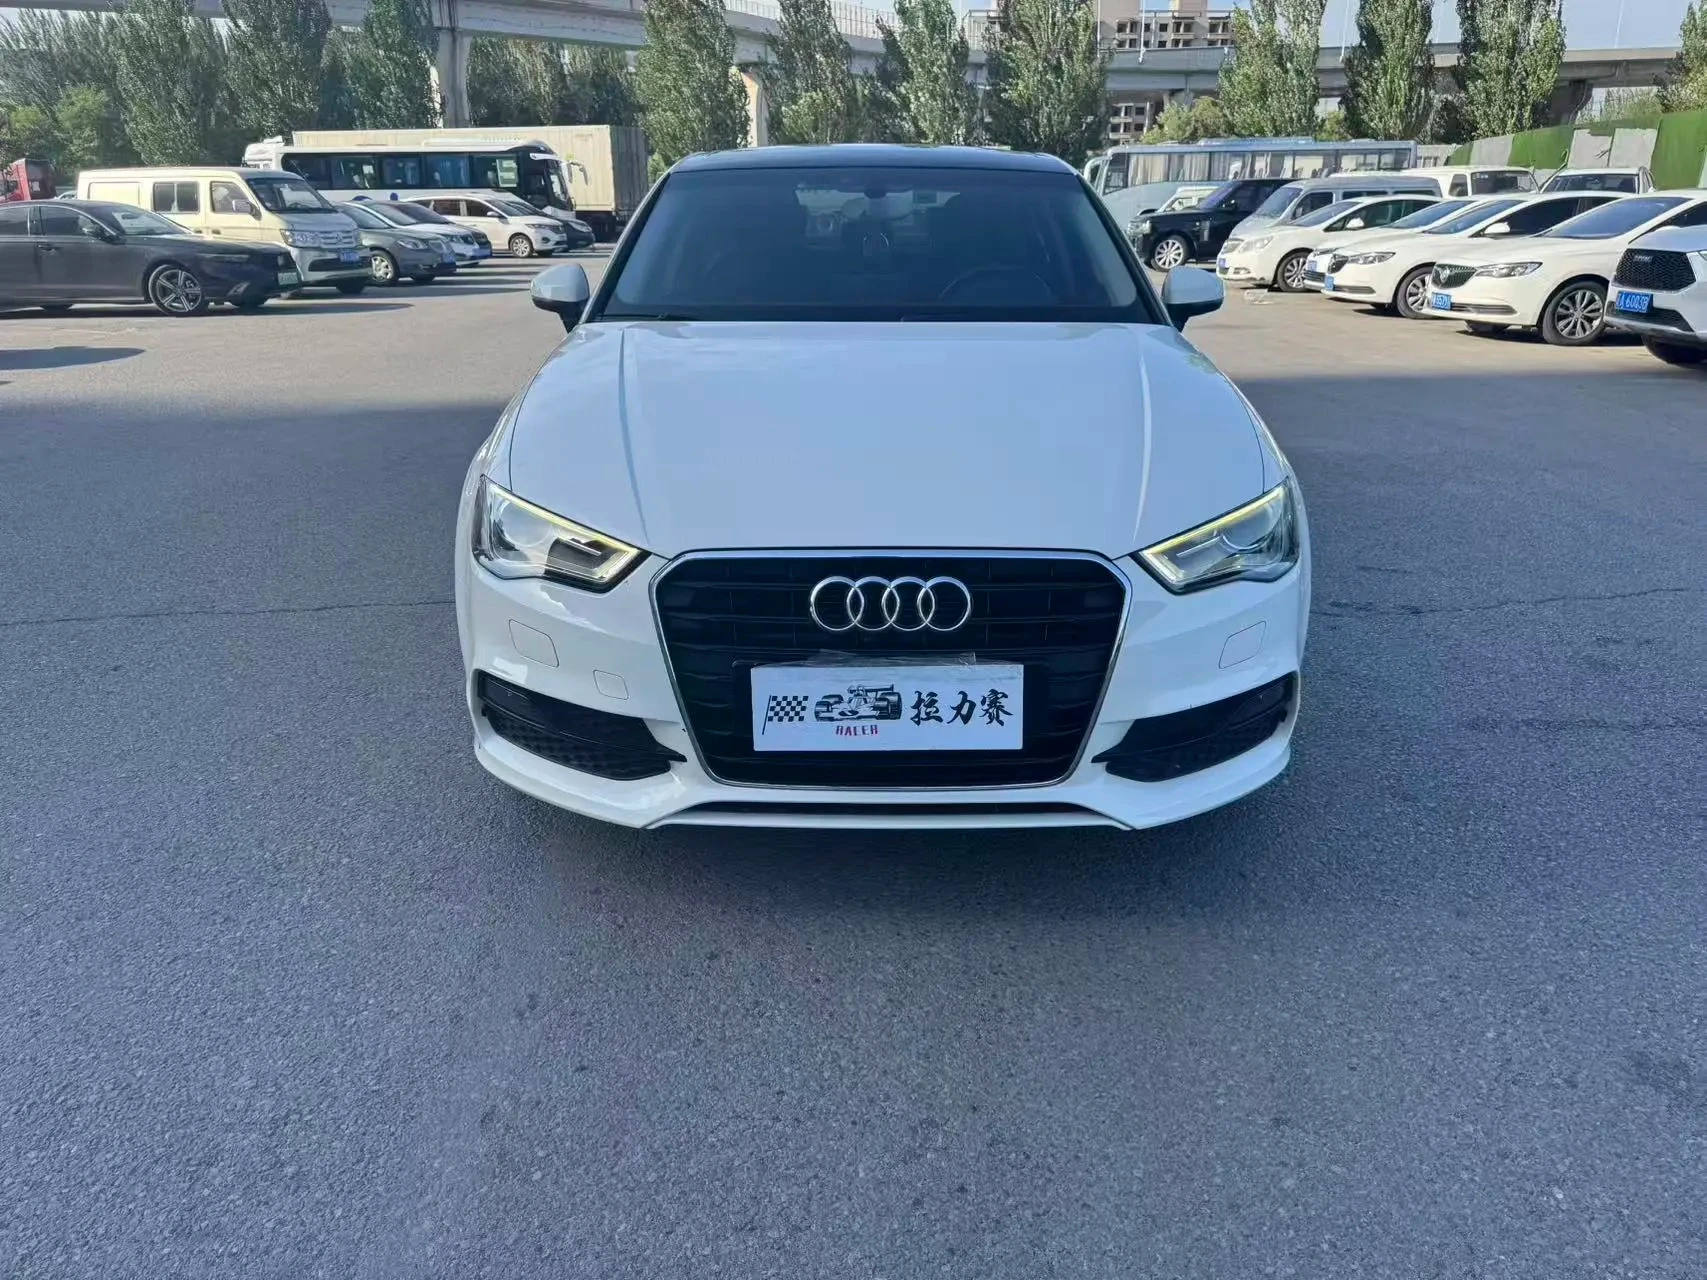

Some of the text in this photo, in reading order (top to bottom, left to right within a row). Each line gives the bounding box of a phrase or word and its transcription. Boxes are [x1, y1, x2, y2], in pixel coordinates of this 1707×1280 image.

[910, 689, 1013, 726] 拉力赛
[835, 724, 878, 736] RACER
